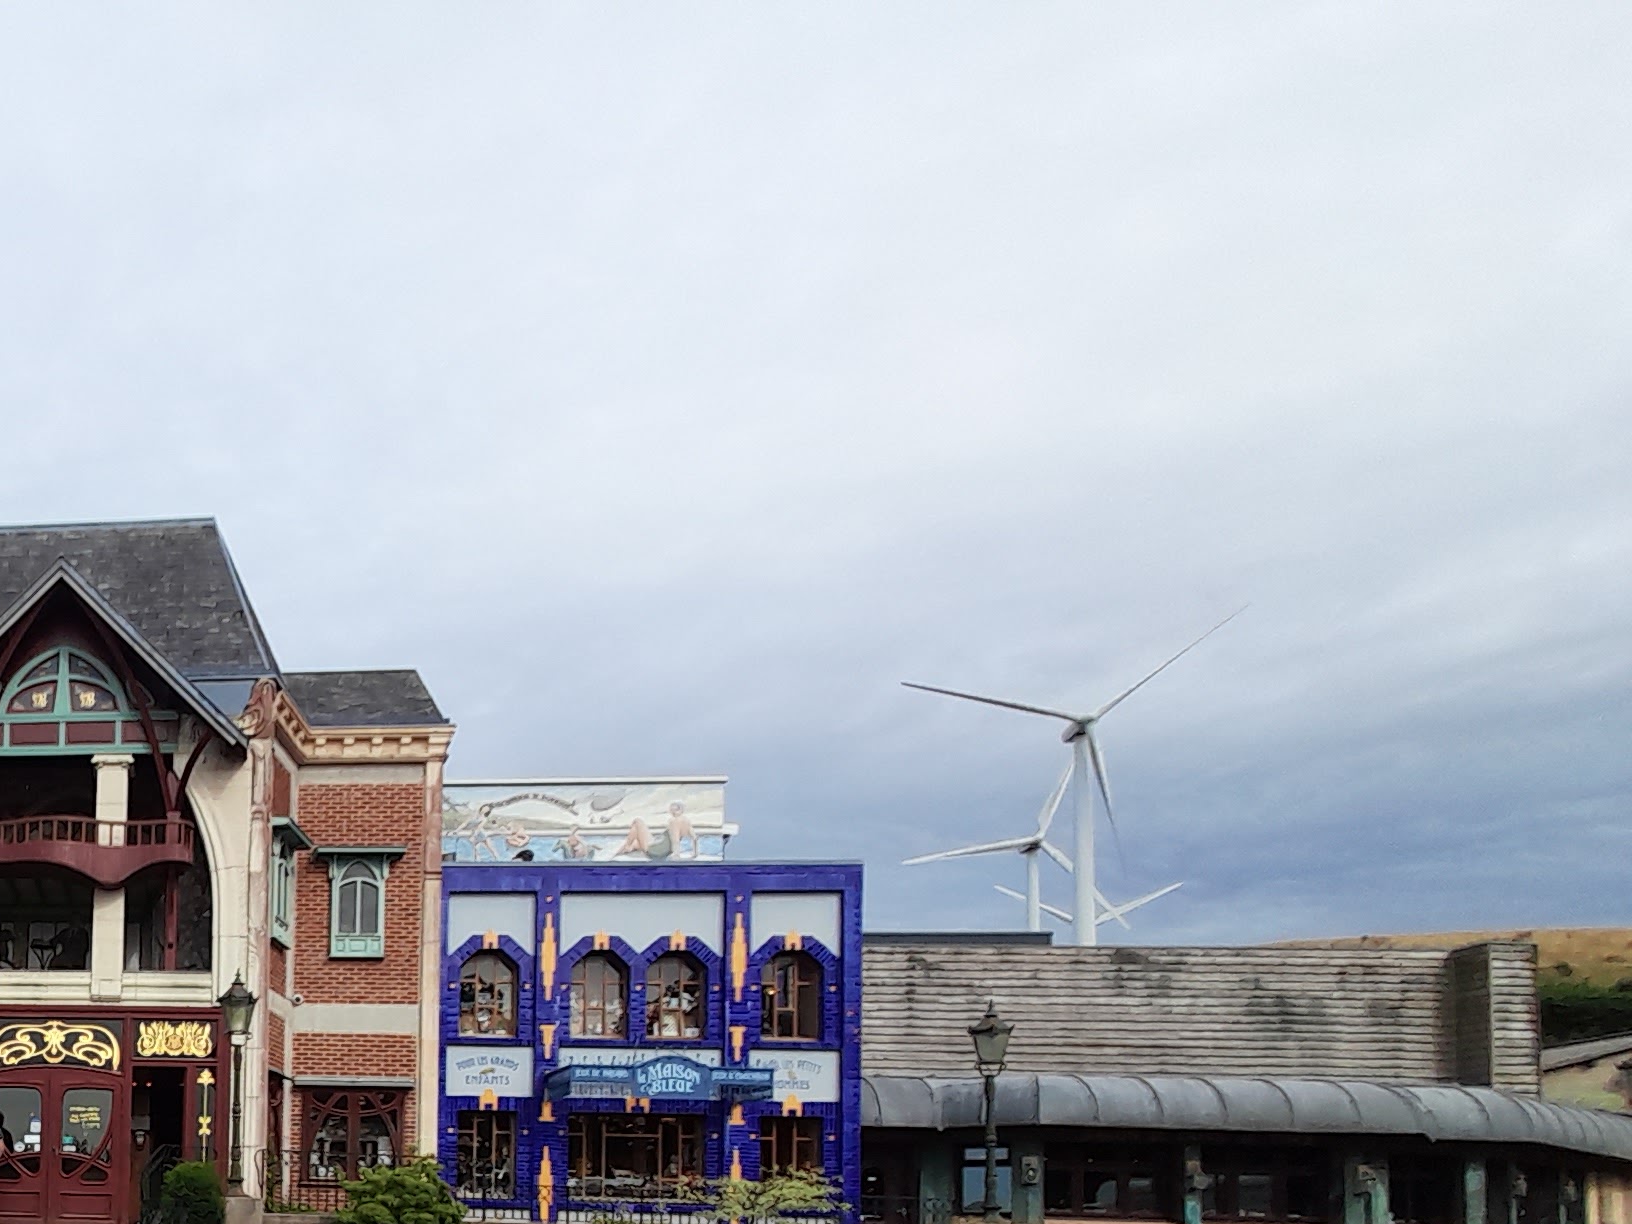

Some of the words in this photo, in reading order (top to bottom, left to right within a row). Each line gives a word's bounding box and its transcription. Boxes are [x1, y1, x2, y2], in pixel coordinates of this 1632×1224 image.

[465, 1074, 511, 1086] ENFANTS
[648, 1062, 702, 1085] MAISON
[649, 1079, 696, 1096] BLEUE
